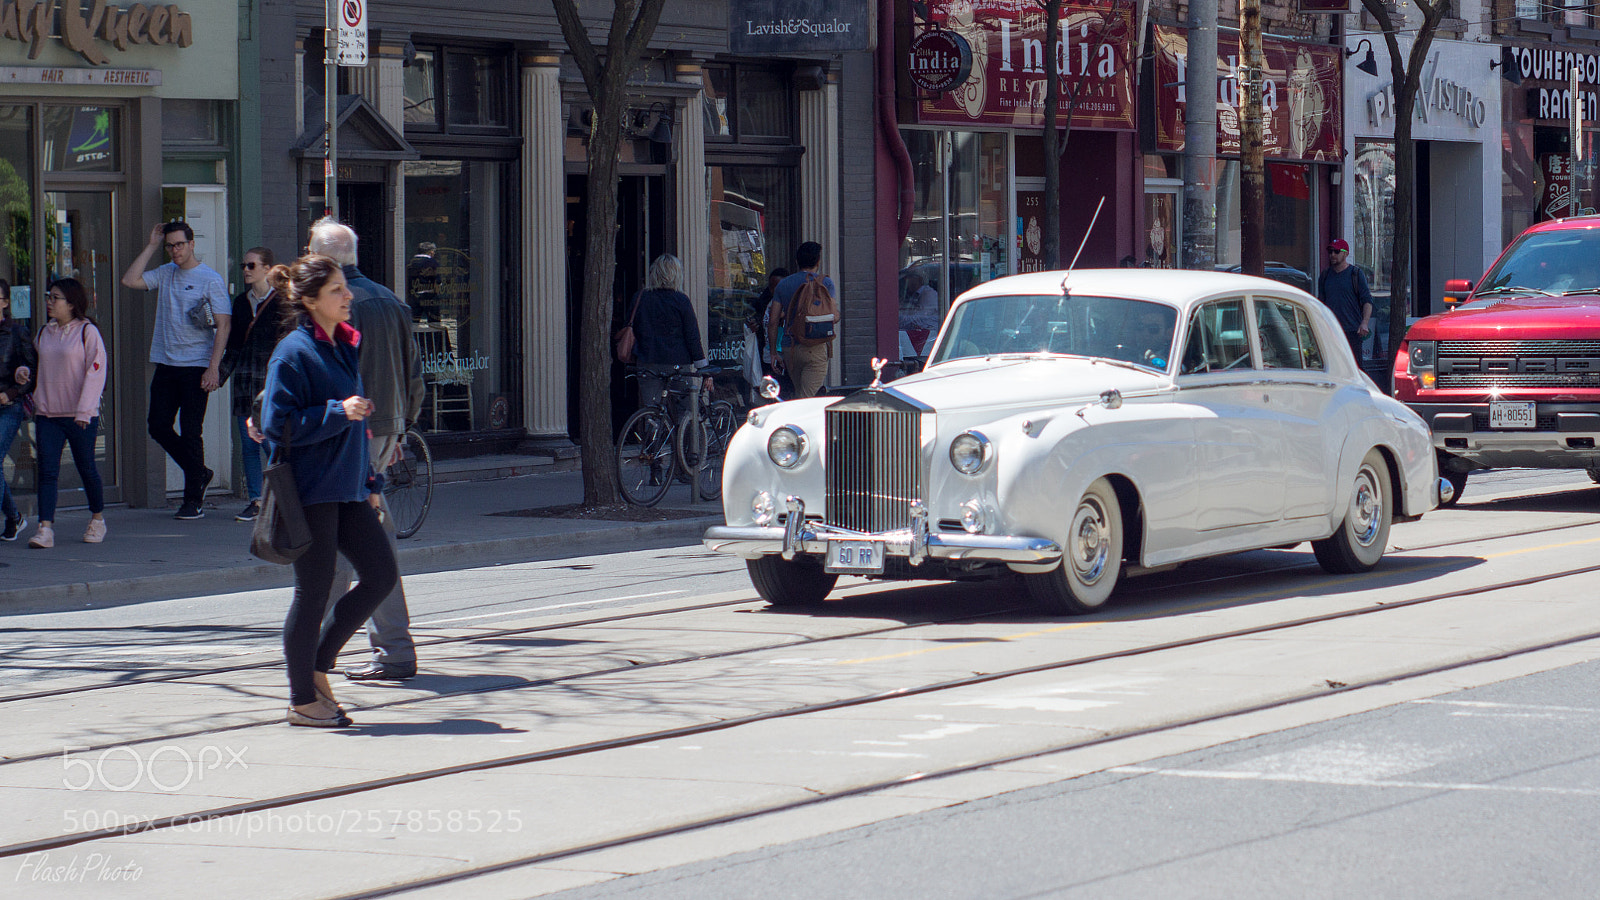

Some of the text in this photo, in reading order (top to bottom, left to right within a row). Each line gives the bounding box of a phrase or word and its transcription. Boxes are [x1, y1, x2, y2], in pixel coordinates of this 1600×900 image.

[61, 0, 193, 66] Queen
[746, 18, 851, 38] Lavish&Squalor
[998, 17, 1117, 78] India
[909, 50, 959, 70] India
[41, 69, 150, 84] HAIR AESTHETIC
[1175, 52, 1279, 112] Ida
[999, 77, 1117, 98] RESTURANT
[1026, 196, 1039, 206] 255
[421, 350, 490, 377] ish&Squalor
[1507, 409, 1533, 421] 80551
[859, 547, 873, 564] RR
